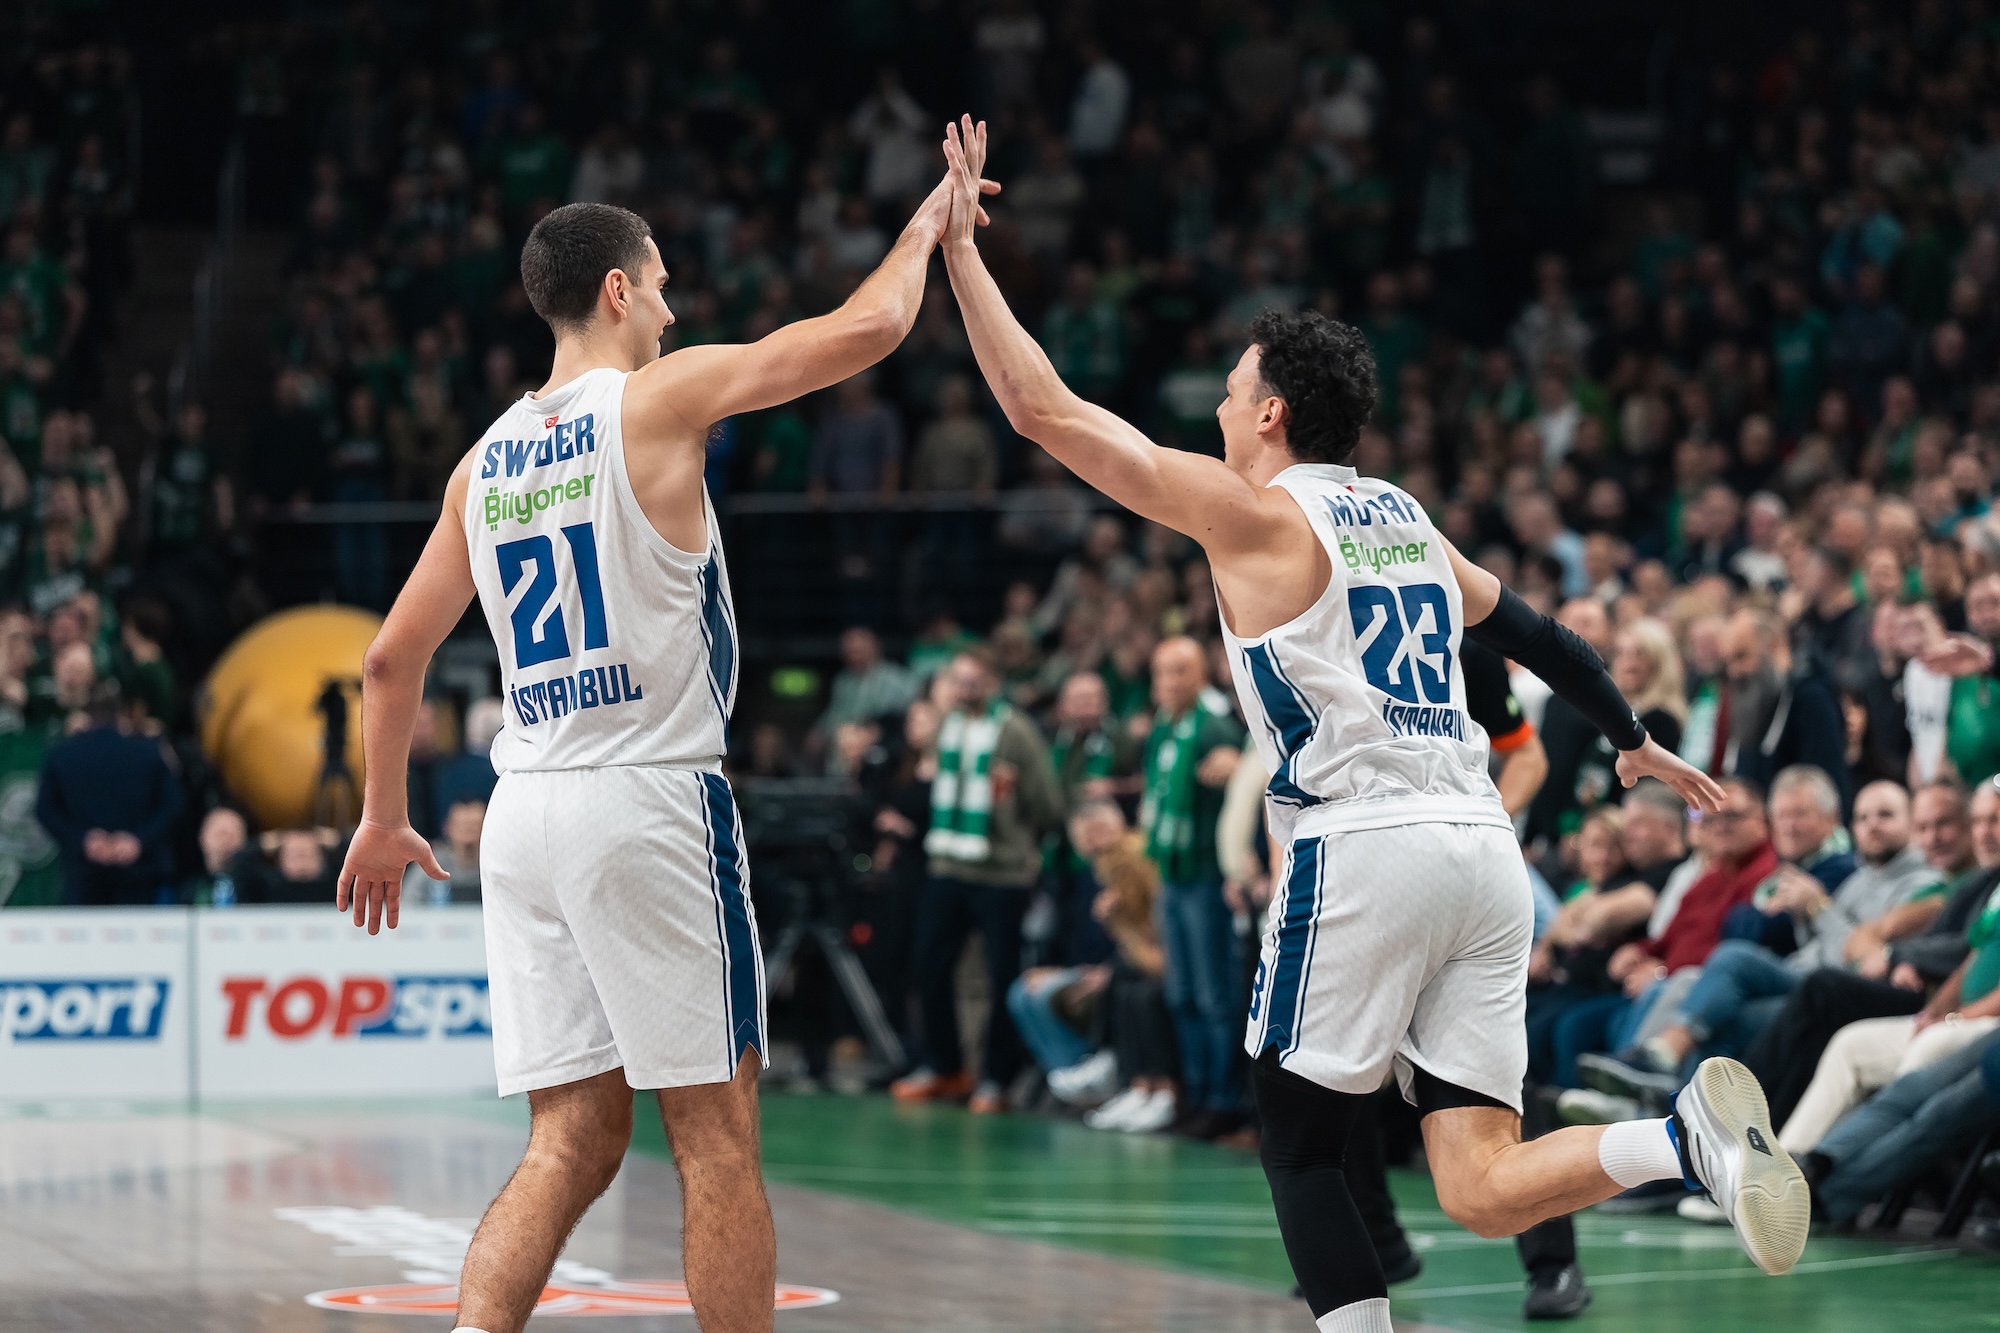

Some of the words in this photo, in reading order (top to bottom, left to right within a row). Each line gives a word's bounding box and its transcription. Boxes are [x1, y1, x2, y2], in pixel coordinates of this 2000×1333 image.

[484, 473, 595, 532] Bilyoner
[1339, 534, 1428, 575] Bilyoner
[495, 521, 609, 670] 21
[1347, 582, 1453, 704] 23
[222, 977, 492, 1043] TOPsp
